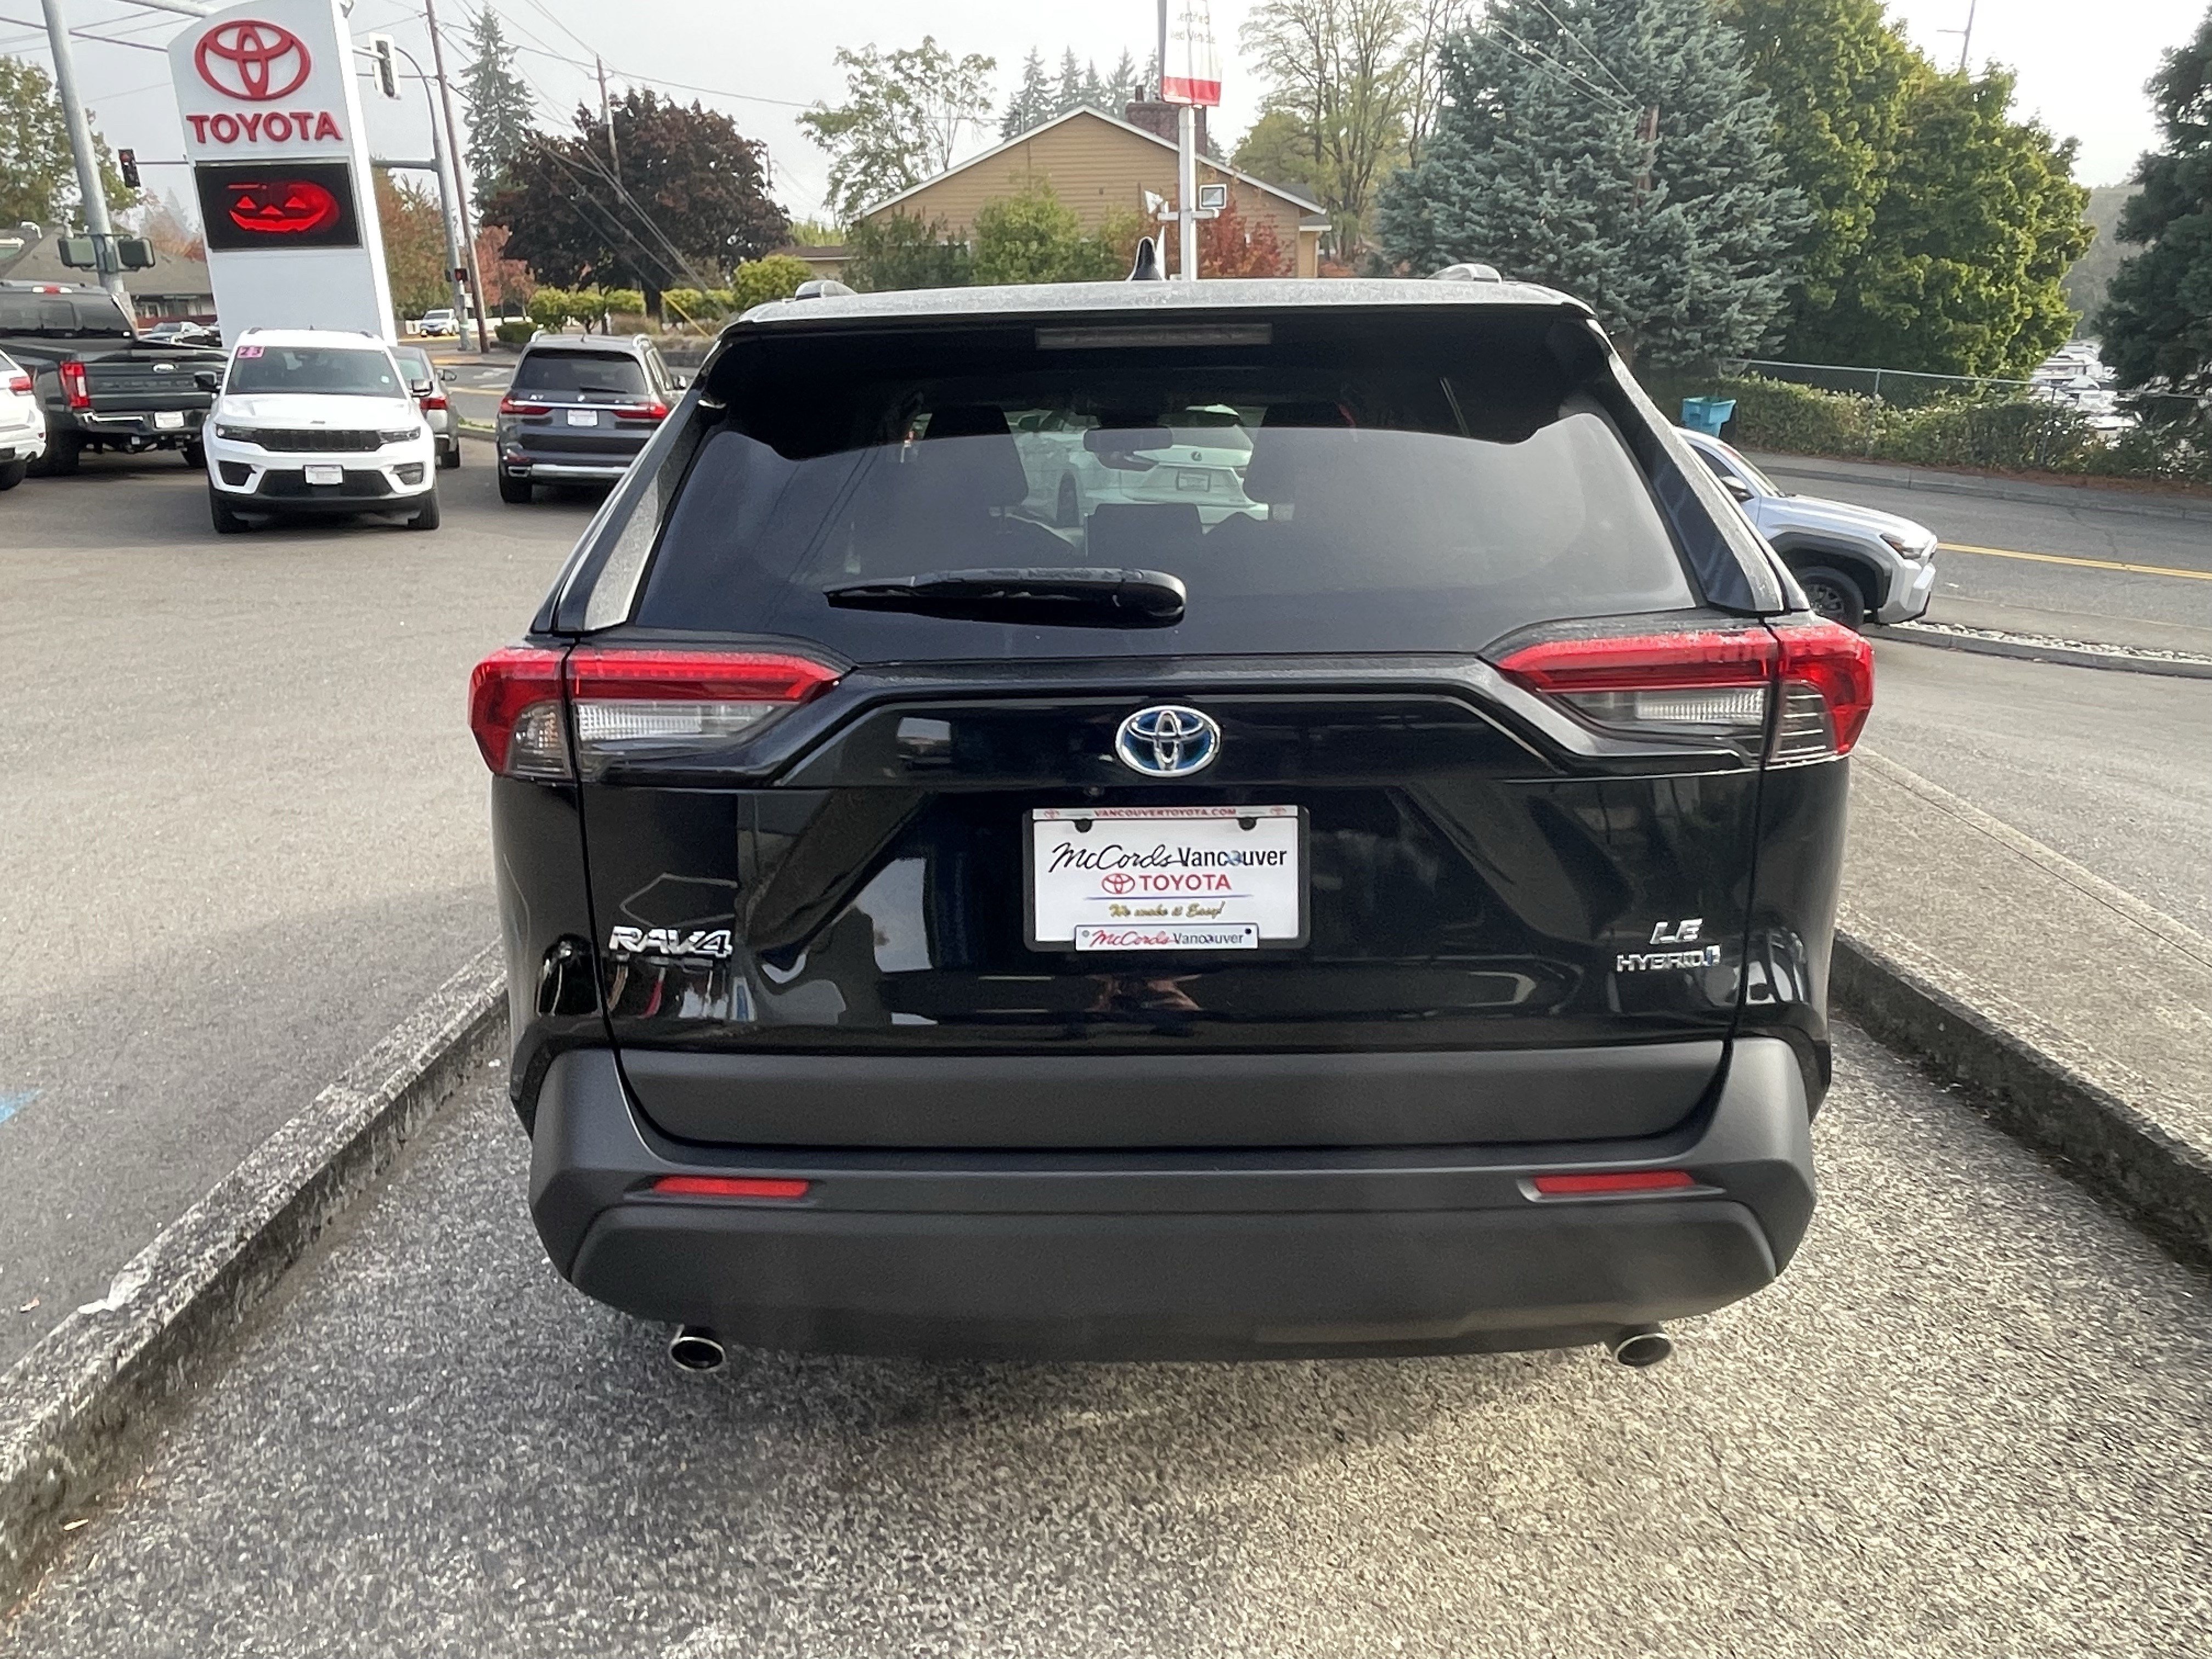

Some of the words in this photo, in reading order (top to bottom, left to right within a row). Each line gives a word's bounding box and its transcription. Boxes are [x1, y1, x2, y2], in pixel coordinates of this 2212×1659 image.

[186, 111, 343, 144] TOYOTA
[1094, 808, 1237, 817] VANCOUVERTOYOTA.COM
[1048, 842, 1178, 872] McCords
[1178, 847, 1287, 867] Vancouver
[1139, 874, 1232, 891] TOYOTA
[609, 926, 733, 958] RAV4
[1089, 930, 1171, 947] McCords
[1172, 932, 1244, 945] Vancouver
[1649, 918, 1703, 945] LE
[1617, 950, 1704, 972] HYBRID
